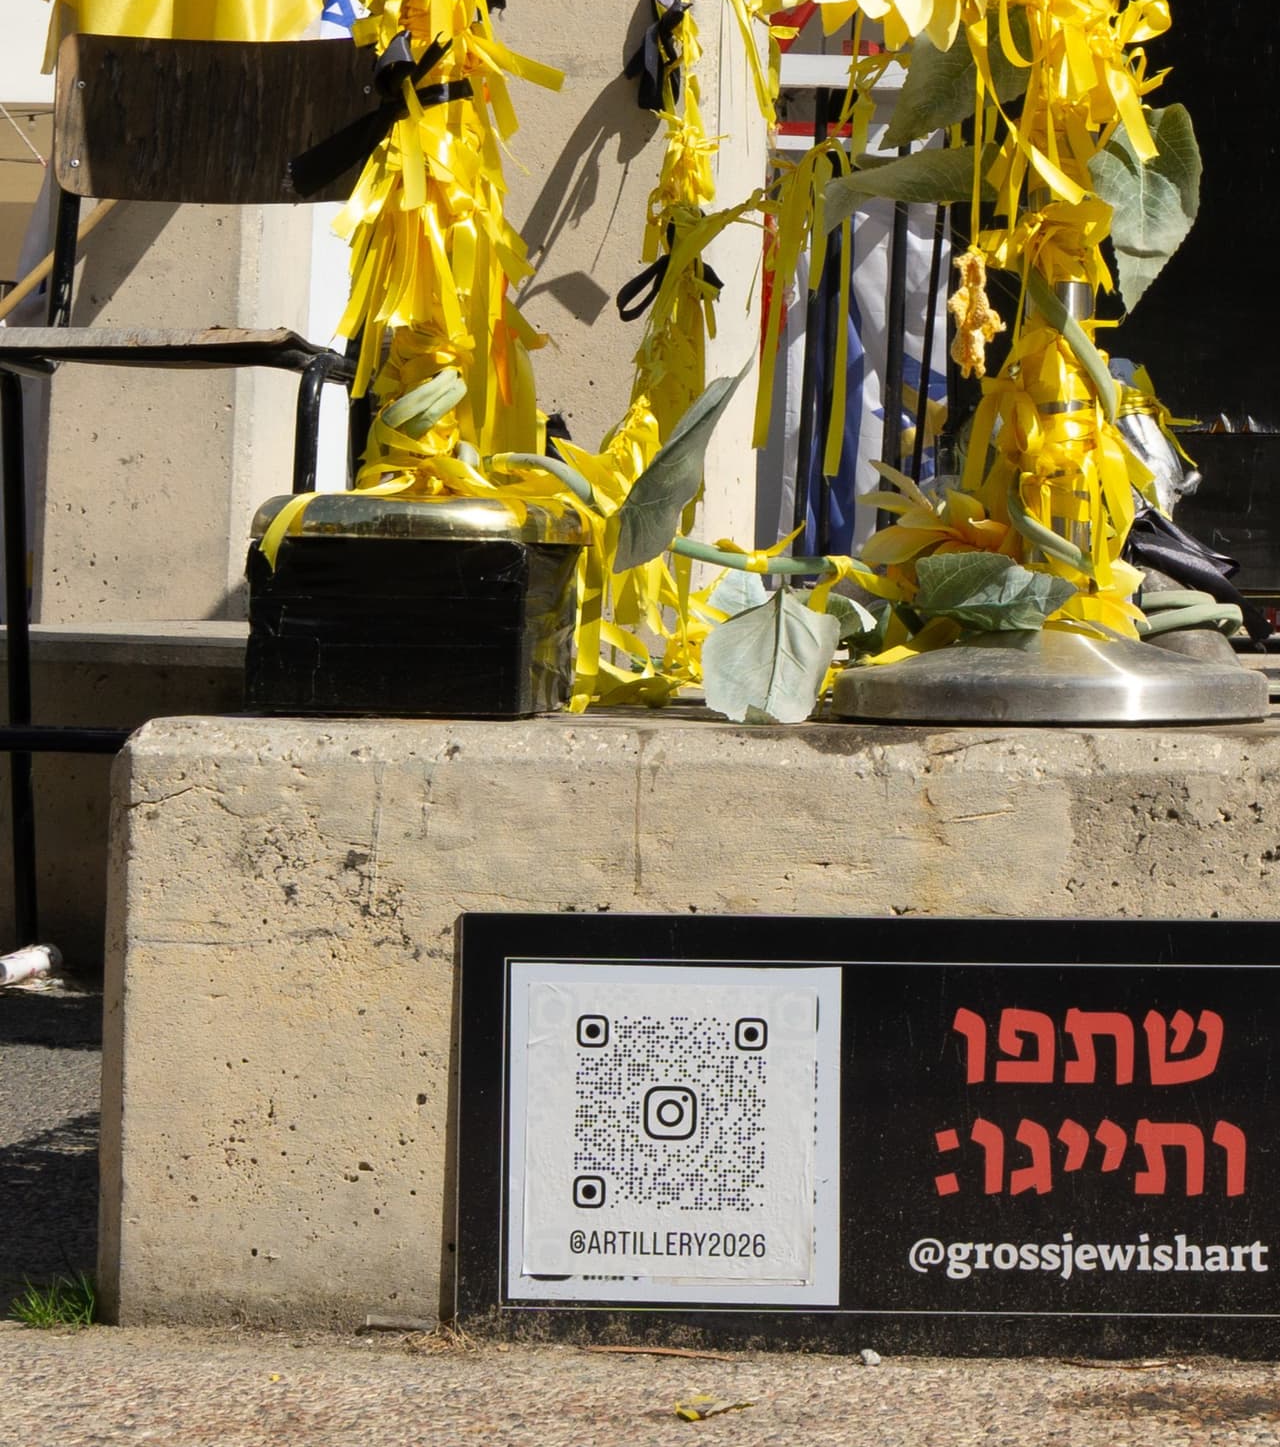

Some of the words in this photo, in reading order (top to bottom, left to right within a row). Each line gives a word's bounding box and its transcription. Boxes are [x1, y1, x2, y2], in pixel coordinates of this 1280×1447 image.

[952, 1006, 1224, 1086] שתפו
[934, 1117, 1248, 1198] ותייגו:
[569, 1229, 766, 1258] @ARTILLERY2026
[908, 1233, 1270, 1281] @grossjewishart
